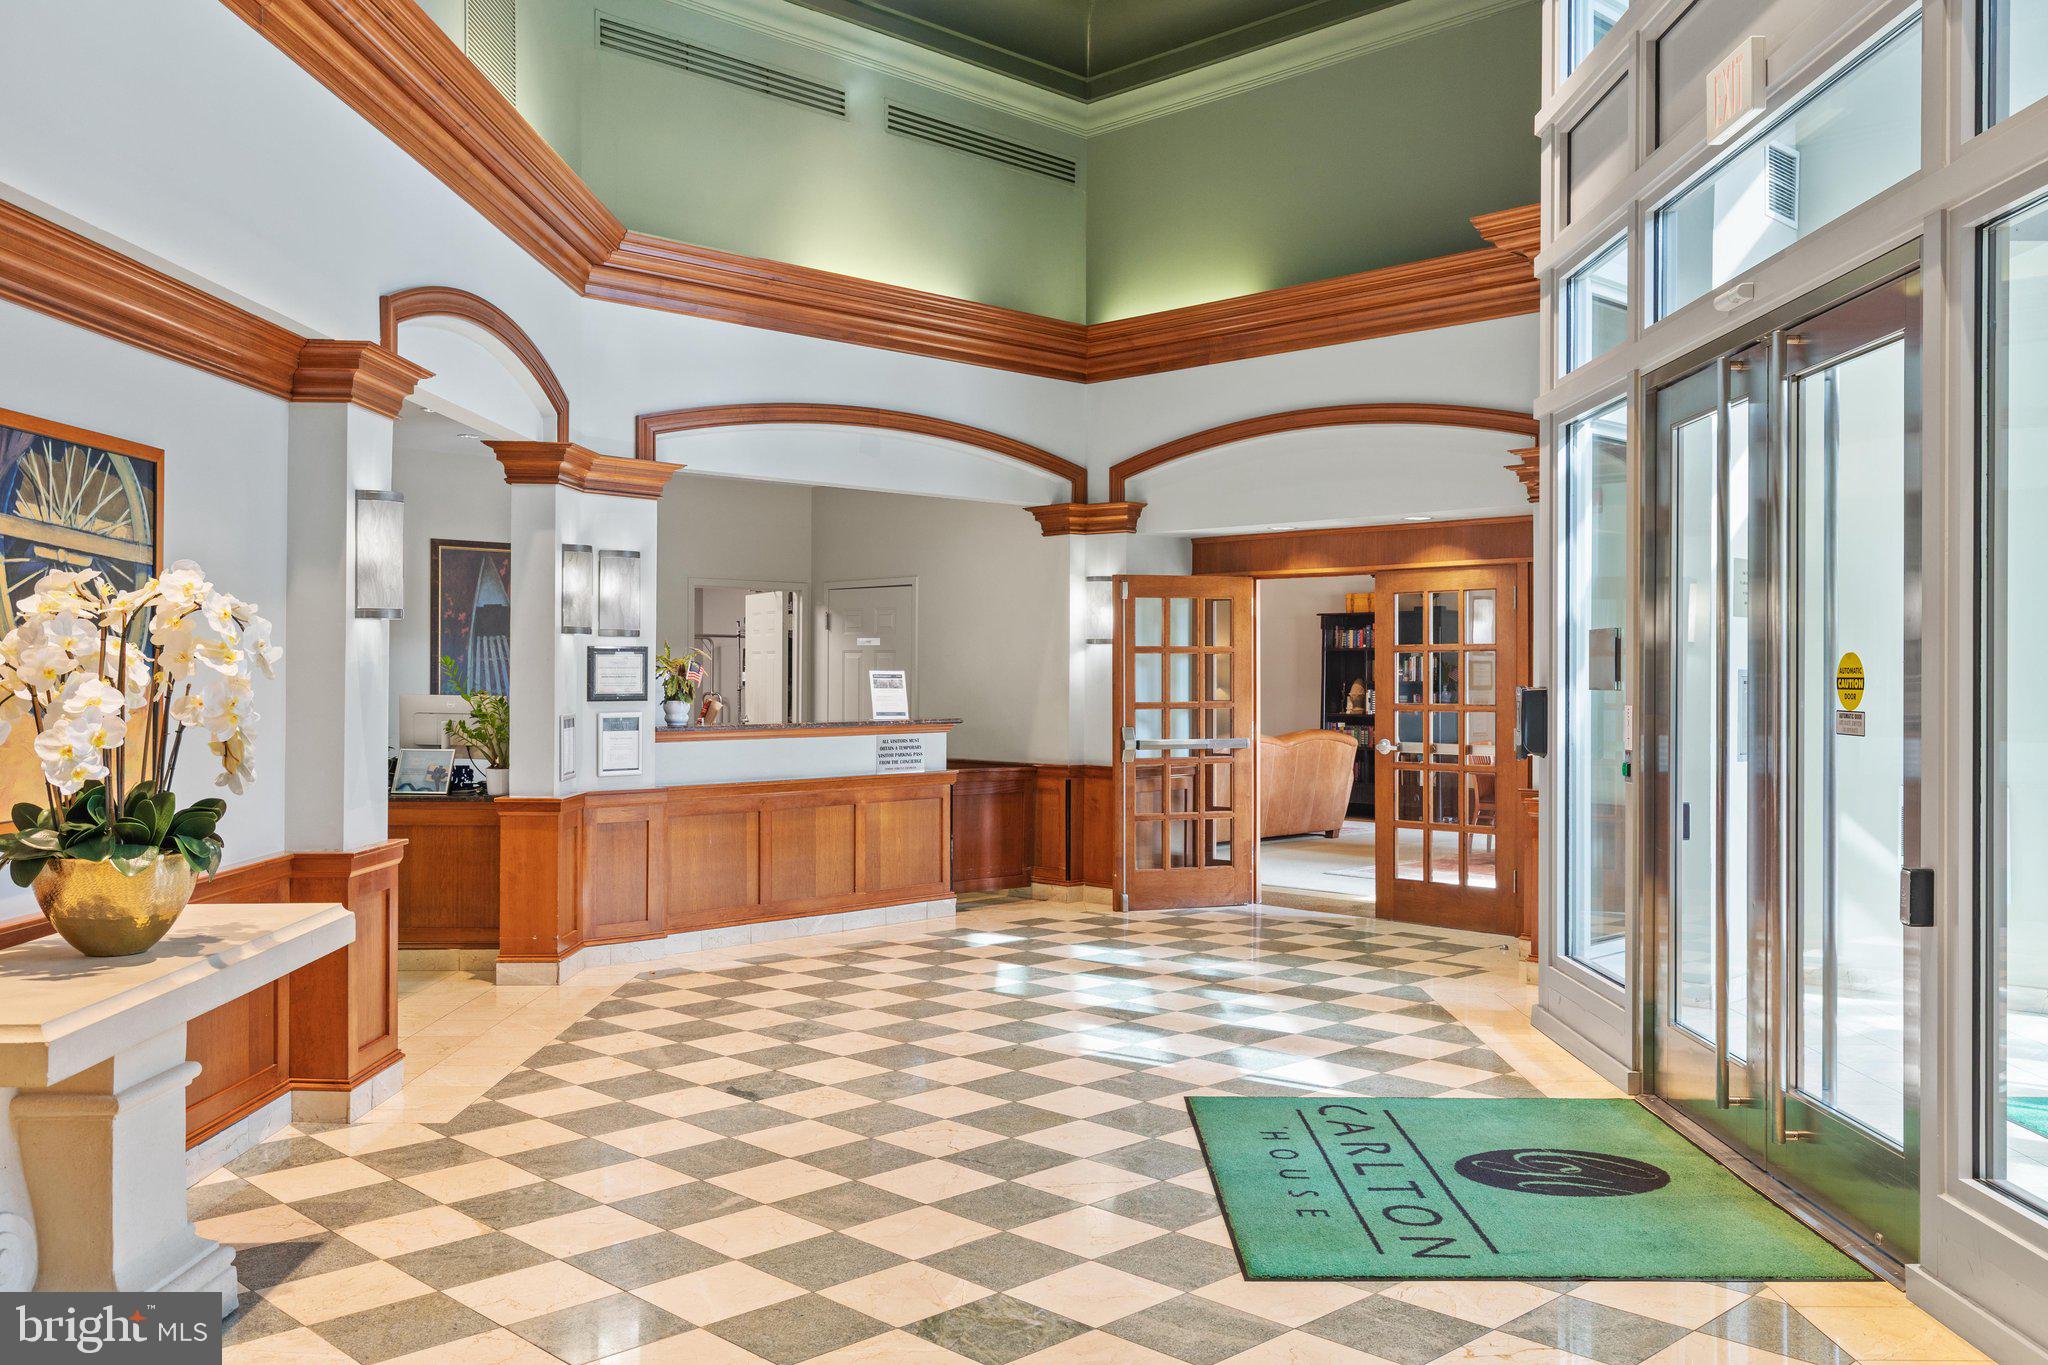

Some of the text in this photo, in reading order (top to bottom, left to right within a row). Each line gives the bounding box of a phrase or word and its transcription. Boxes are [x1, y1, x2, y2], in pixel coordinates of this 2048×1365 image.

[1713, 52, 1744, 128] EXIT
[1838, 678, 1863, 689] CAUTION
[1839, 667, 1862, 675] AUTOMATIC
[1844, 692, 1857, 700] DOOR
[1259, 1130, 1330, 1217] HOUSE
[1318, 1104, 1471, 1259] CARLTON
